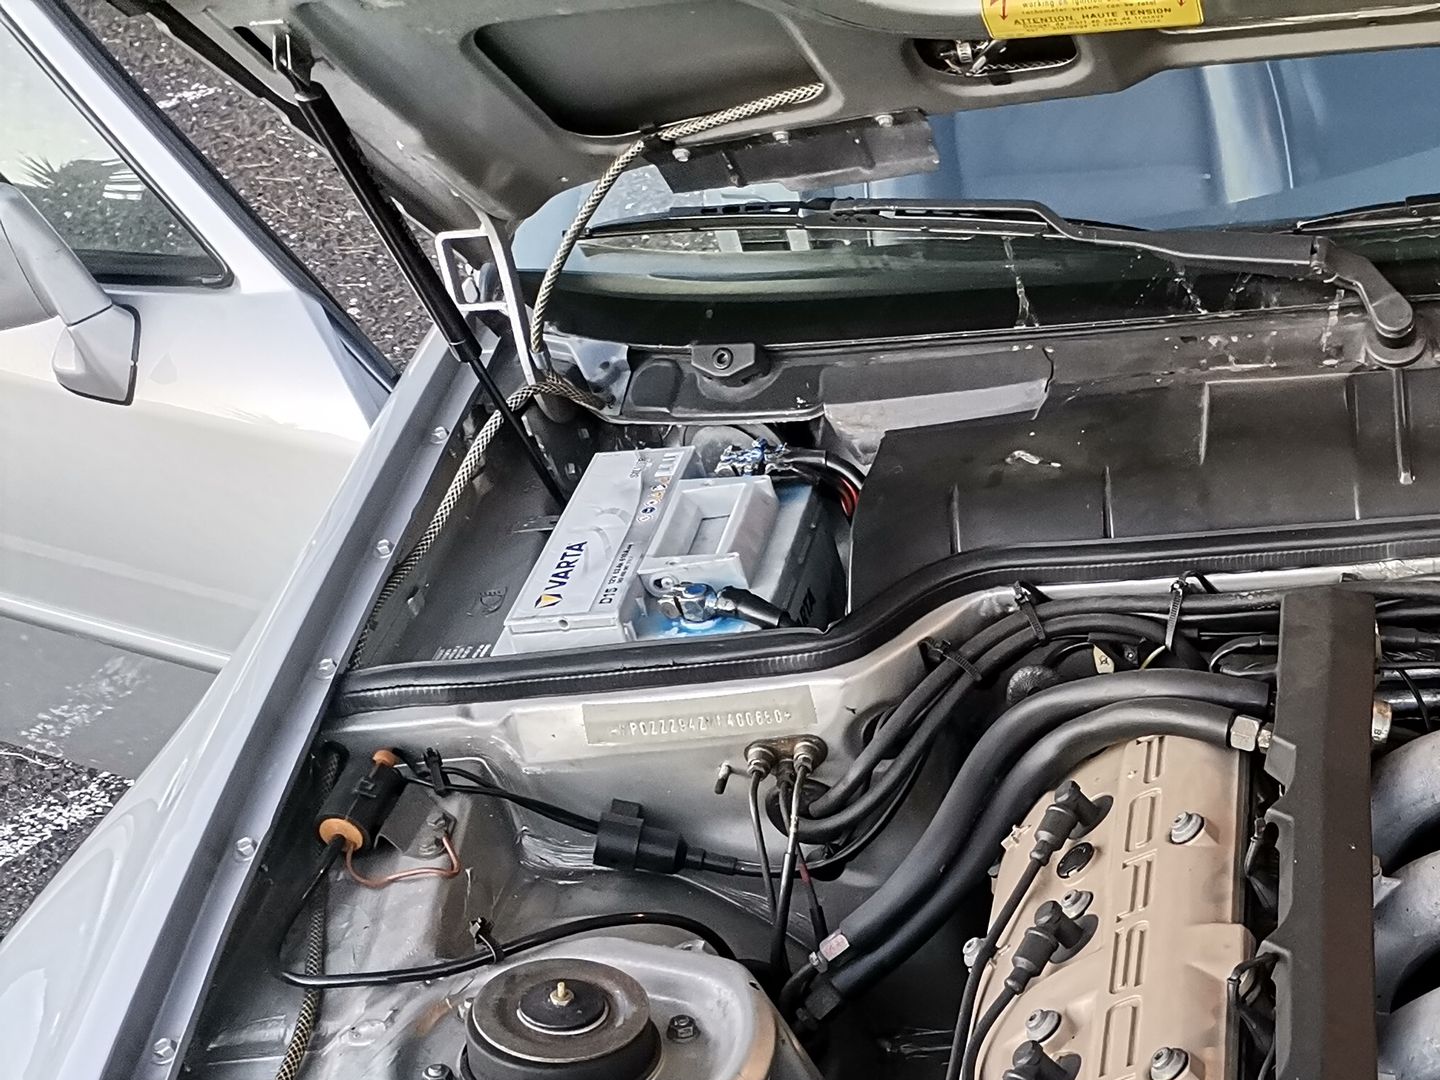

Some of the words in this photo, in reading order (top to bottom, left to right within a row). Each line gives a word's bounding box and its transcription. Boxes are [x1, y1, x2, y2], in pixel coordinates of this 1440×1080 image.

[1014, 15, 1073, 26] ATTENTION
[1082, 12, 1118, 20] HAUTE
[1124, 8, 1172, 17] TENSION
[544, 541, 588, 591] VARTA
[599, 587, 618, 604] D15
